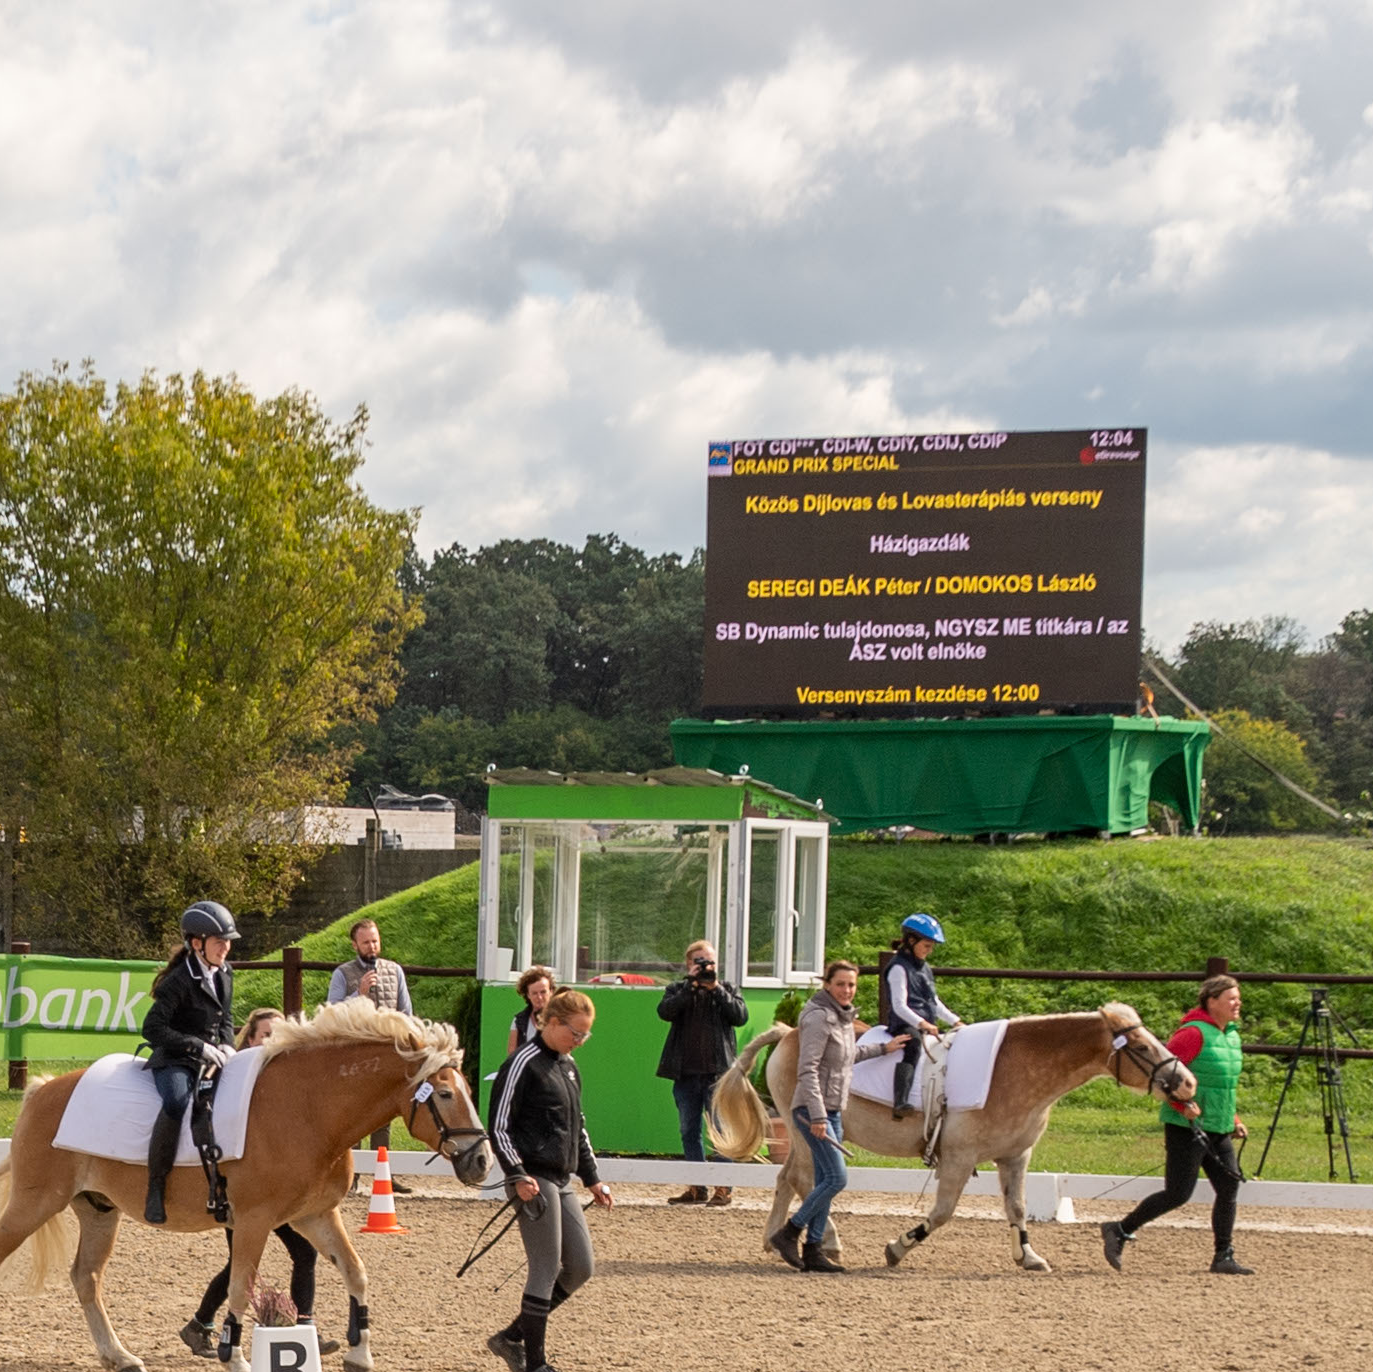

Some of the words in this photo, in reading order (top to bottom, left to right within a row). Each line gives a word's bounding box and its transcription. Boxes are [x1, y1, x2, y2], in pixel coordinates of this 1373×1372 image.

[967, 432, 1008, 449] CDIP
[1089, 430, 1133, 447] 12:04
[734, 457, 790, 475] GRAND
[792, 456, 829, 473] PRIX
[832, 454, 900, 472] SPECIAL
[745, 495, 799, 514] Közös
[876, 491, 898, 510] és
[902, 488, 1027, 511] Lovasterápiás
[1030, 489, 1103, 509] verseny
[747, 579, 815, 598] SEREGI
[819, 574, 871, 597] DEÁK
[875, 577, 921, 595] Péter
[924, 576, 932, 594] /
[935, 574, 1033, 594] DOMOKOS
[1037, 573, 1098, 592] László
[716, 623, 740, 640] SB
[745, 622, 820, 644] Dynamic
[824, 620, 931, 643] tulajdonosa,
[935, 618, 1000, 636] NGYSZ
[1003, 618, 1032, 635] ME
[1095, 616, 1105, 634] /
[1107, 619, 1129, 634] az
[890, 642, 924, 660] volt
[796, 686, 912, 705] Versenyszám
[915, 684, 987, 702] kezdése
[991, 684, 1040, 702] 12:00
